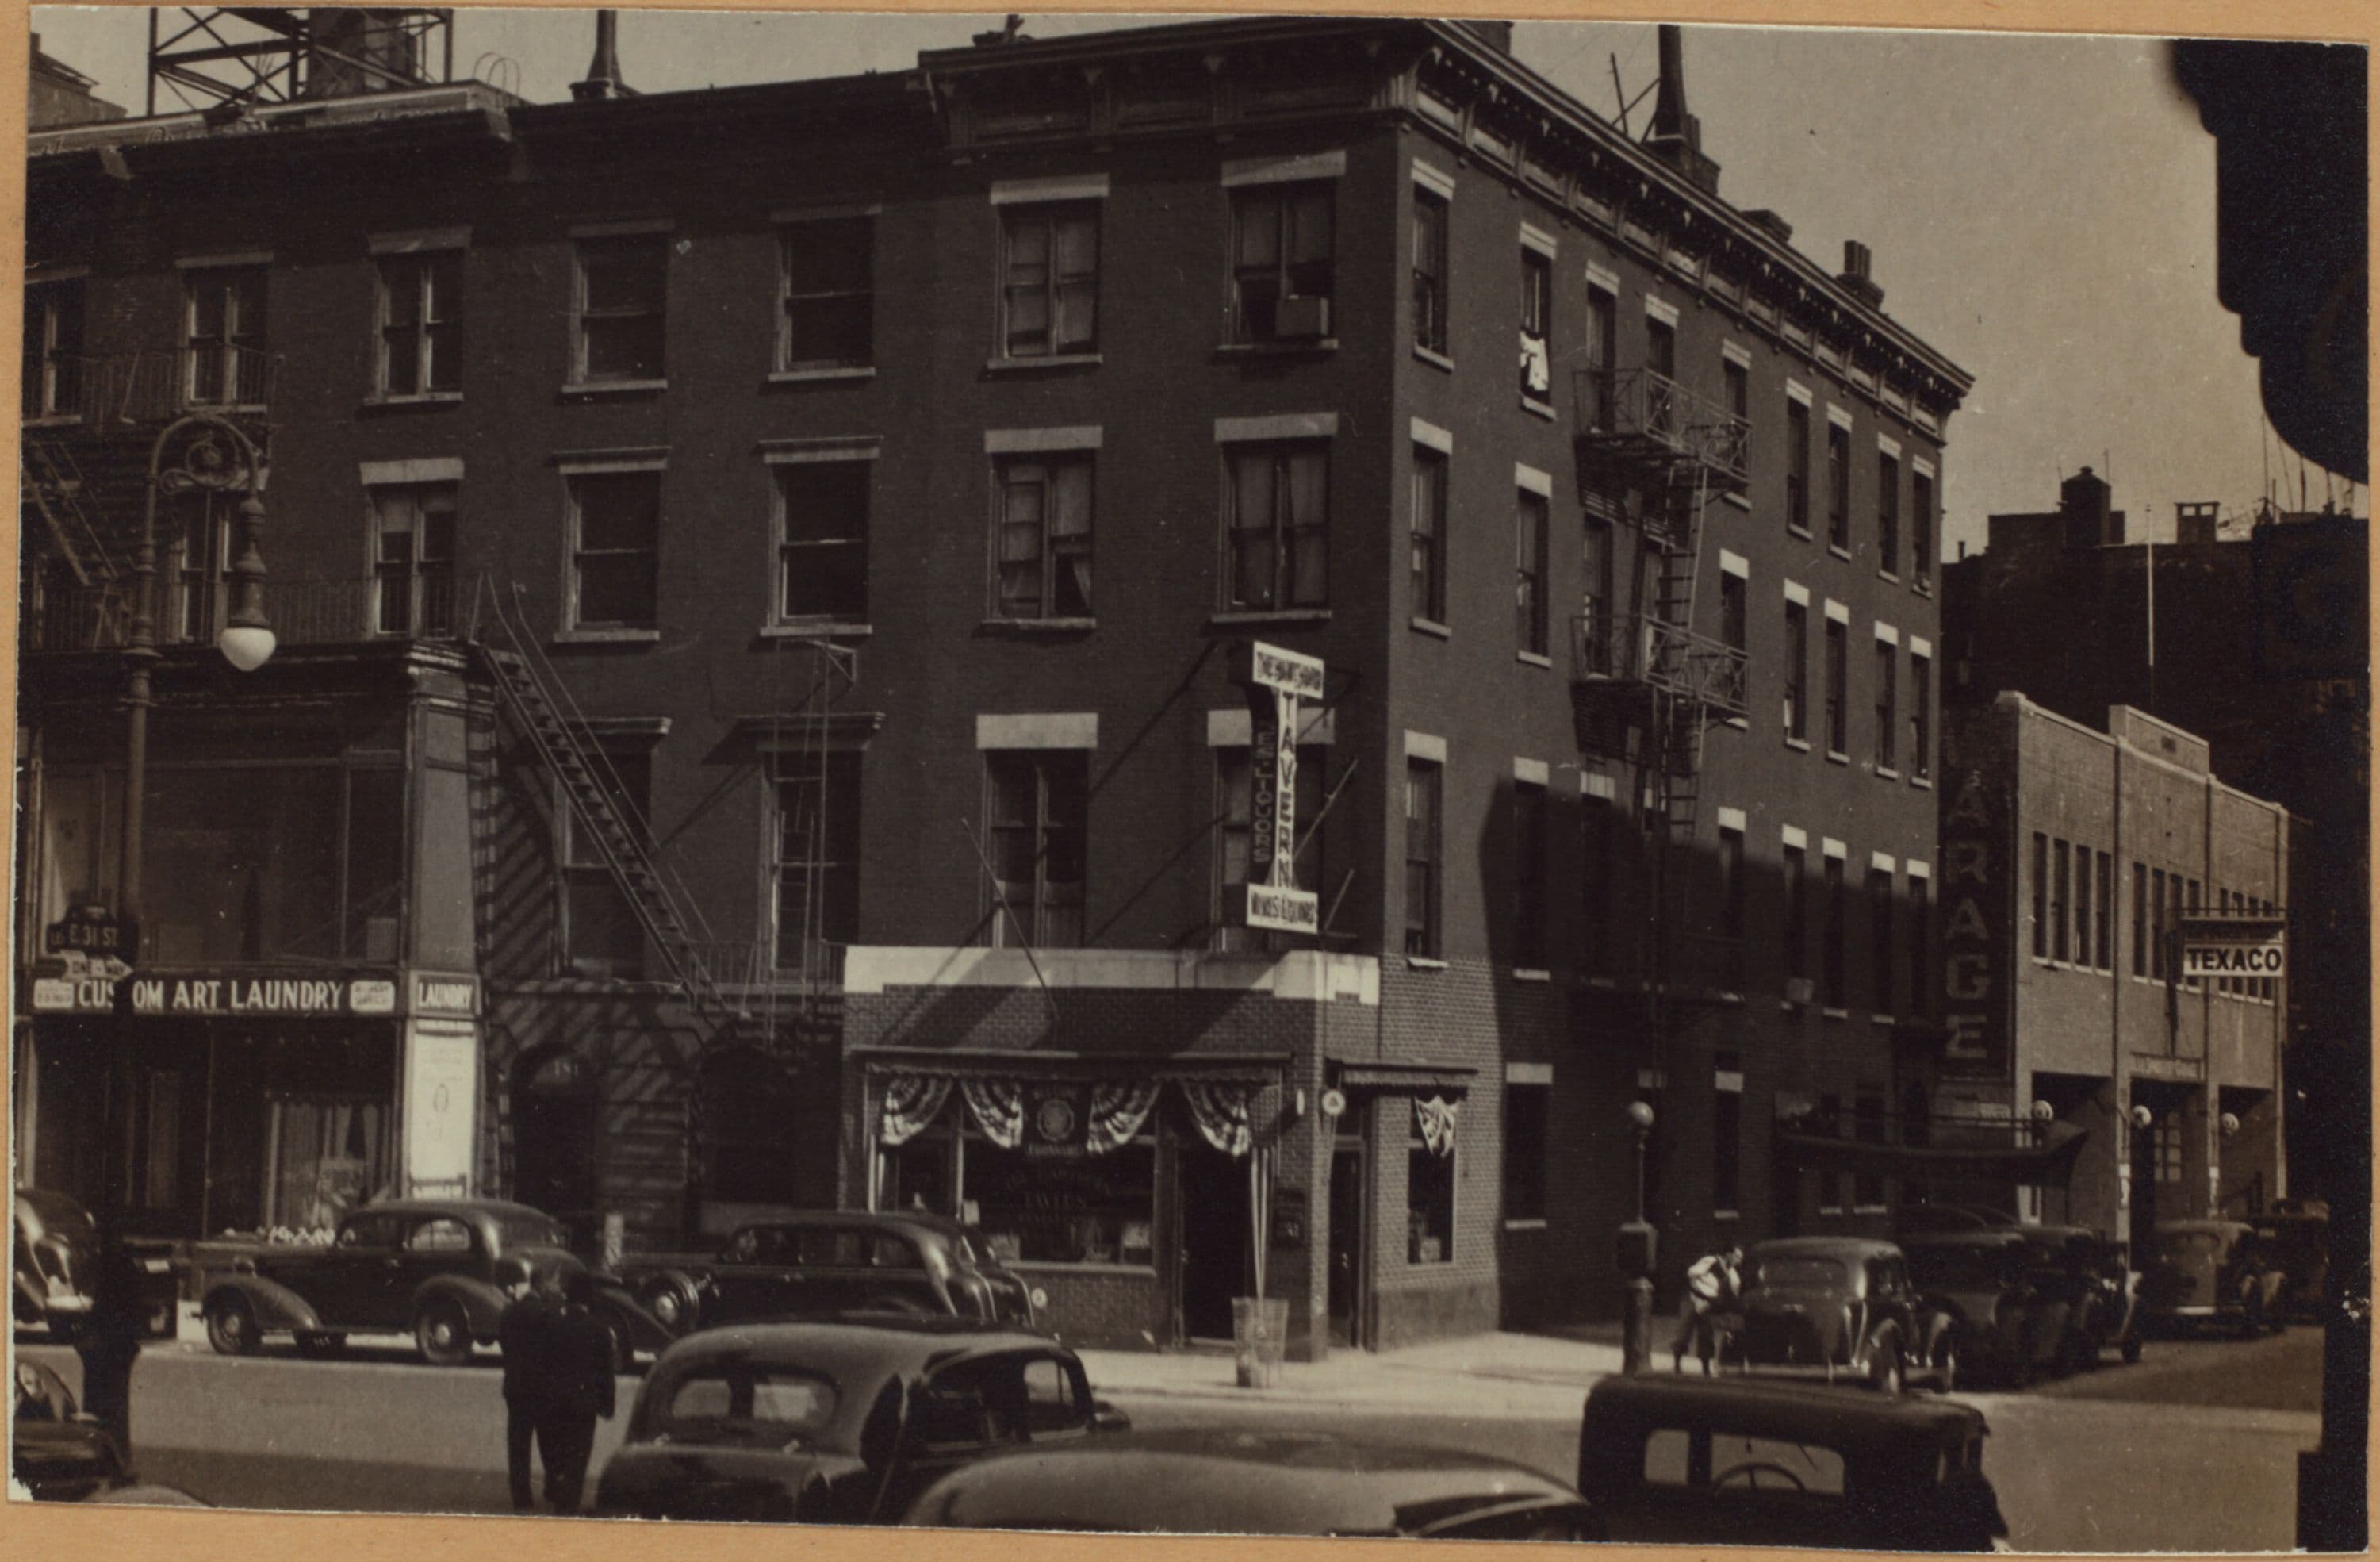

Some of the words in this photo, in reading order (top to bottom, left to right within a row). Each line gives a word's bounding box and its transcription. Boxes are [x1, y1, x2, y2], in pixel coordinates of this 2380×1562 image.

[1278, 692, 1296, 888] TAVERN
[1945, 768, 1991, 1057] ARAGE
[2186, 947, 2282, 971] TEXACO
[79, 980, 163, 1010] CUSOM
[173, 981, 220, 1010] ART
[231, 981, 343, 1011] LAUNDRY
[418, 982, 473, 1010] LAUNDRY
